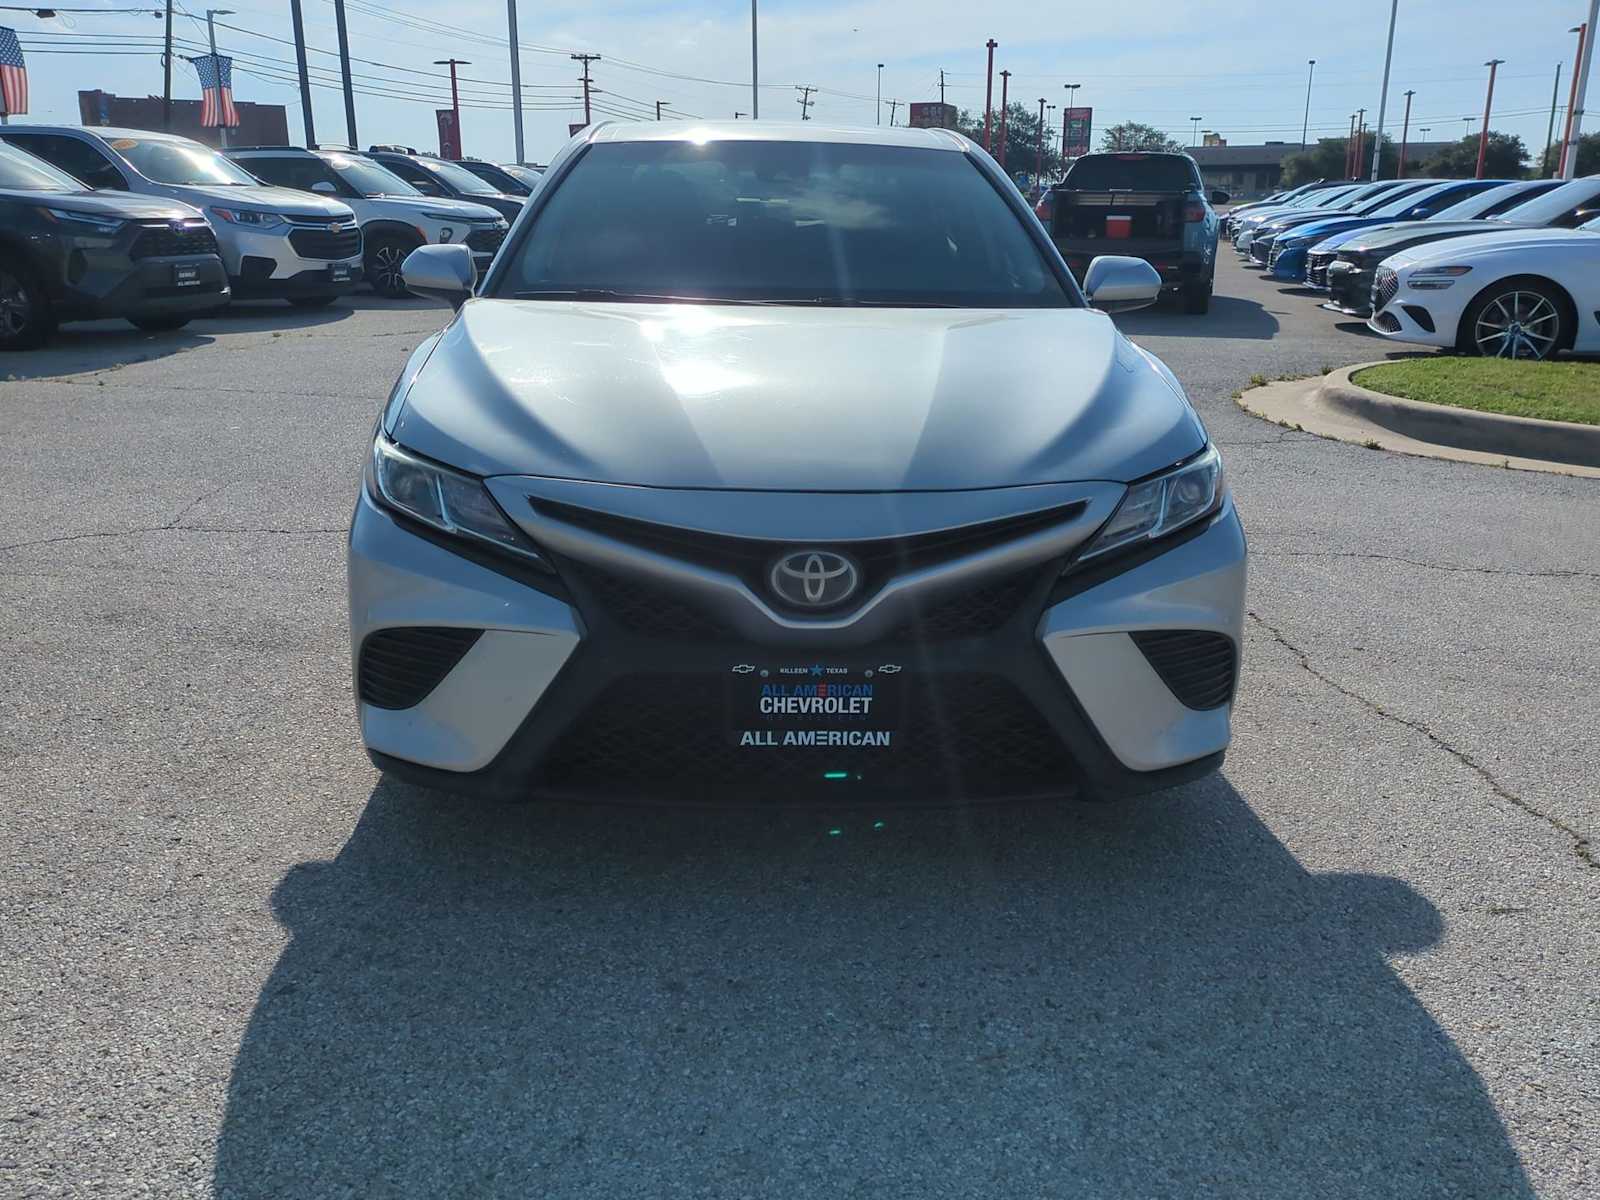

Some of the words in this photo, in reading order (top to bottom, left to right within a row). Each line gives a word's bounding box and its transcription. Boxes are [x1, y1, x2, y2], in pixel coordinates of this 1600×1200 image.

[762, 684, 789, 696] ALL
[794, 683, 873, 697] AMERICAN
[760, 697, 873, 714] CHEVROLET
[740, 731, 778, 746] ALL
[783, 731, 890, 746] AMERICAN
